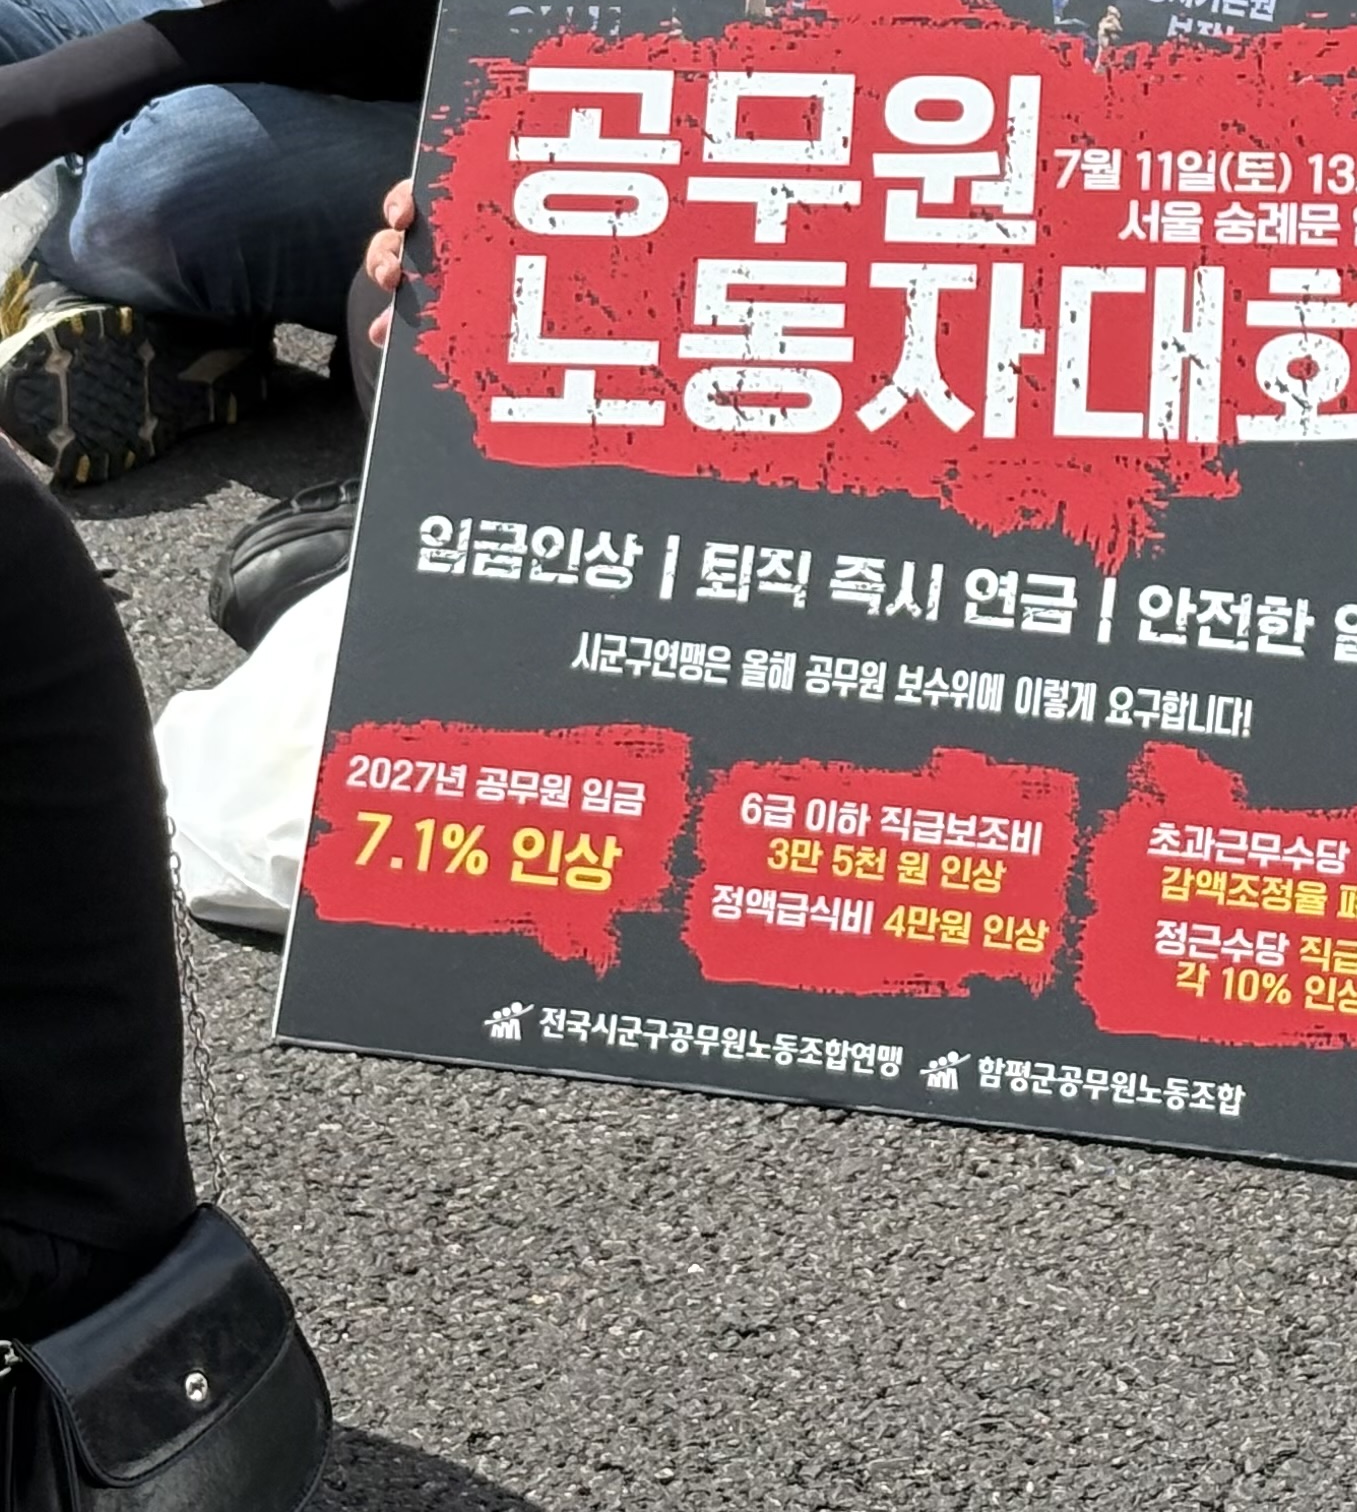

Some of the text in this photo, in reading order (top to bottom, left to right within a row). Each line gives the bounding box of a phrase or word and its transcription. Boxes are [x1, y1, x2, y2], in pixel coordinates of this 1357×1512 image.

[508, 66, 1042, 246] 공무원
[1053, 148, 1122, 190] 7월
[1135, 150, 1292, 194] 11일(토)
[1117, 199, 1204, 243] 서울
[1213, 201, 1341, 246] 숭례문
[415, 514, 643, 591] 임금인상
[696, 541, 812, 609] 퇴직
[828, 553, 944, 622] 즉시
[963, 567, 1078, 636] 연금
[1137, 584, 1315, 657] 안전한
[571, 631, 1254, 738] 시군구연맹은 올해 공무원 보수위에 이렇게 요구합니다!
[345, 753, 647, 817] 2027년 공무원 임금
[354, 810, 624, 892] 7.1% 인상
[740, 792, 1044, 858] 6급 이하 직급보조비
[1145, 821, 1350, 875] 초과근무수당
[766, 836, 1008, 895] 3만 5천 원 인상
[1160, 864, 1329, 917] 감액조정율
[710, 883, 1051, 955] 정액급식비 4만원 인상
[1153, 918, 1291, 967] 정근수당
[1175, 960, 1209, 998] 각
[1220, 965, 1293, 1006] 10%
[538, 1004, 904, 1078] 전국시군구공무원노동조합연맹
[976, 1054, 1247, 1118] 함평군공무원노동조합
